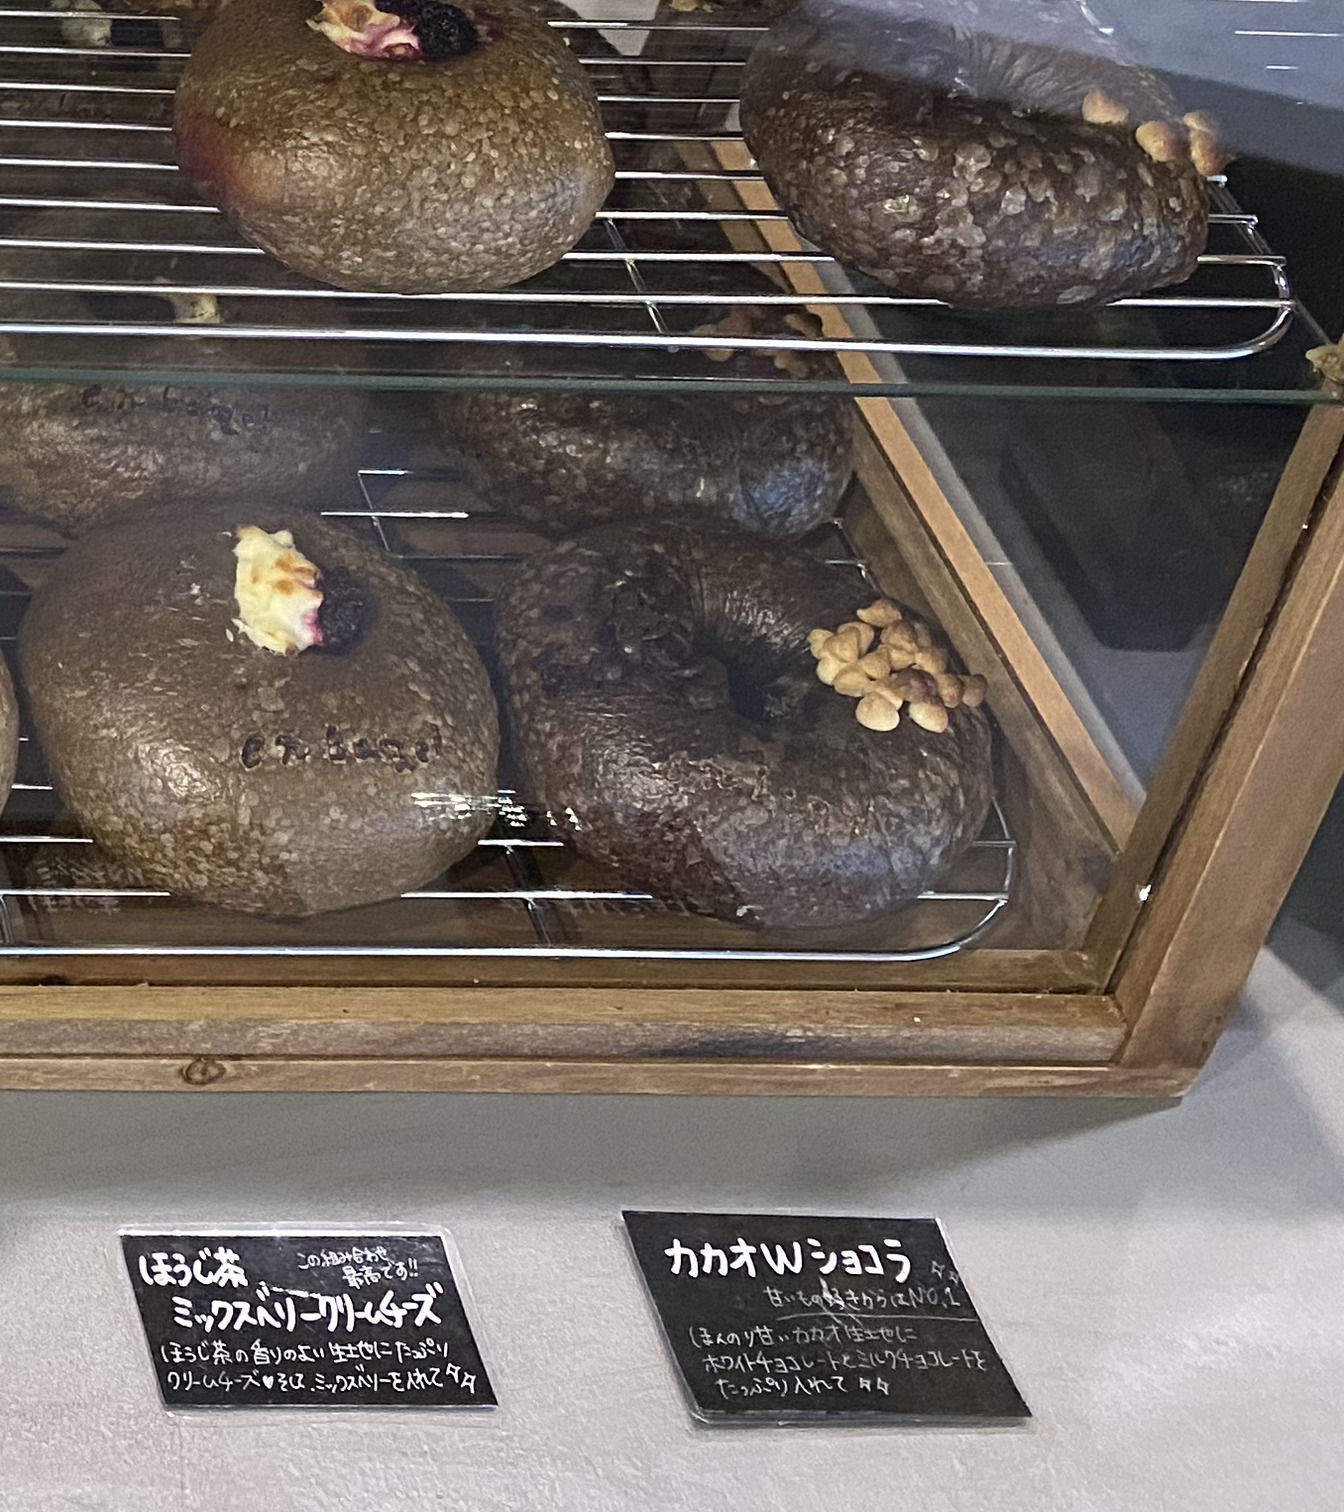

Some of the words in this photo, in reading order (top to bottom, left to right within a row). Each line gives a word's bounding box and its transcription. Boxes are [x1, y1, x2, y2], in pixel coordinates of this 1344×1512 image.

[138, 1245, 249, 1288] ほうじ茶
[664, 1238, 911, 1283] カカオWショコラ
[172, 1282, 444, 1333] ミックスベリークリームチーズ
